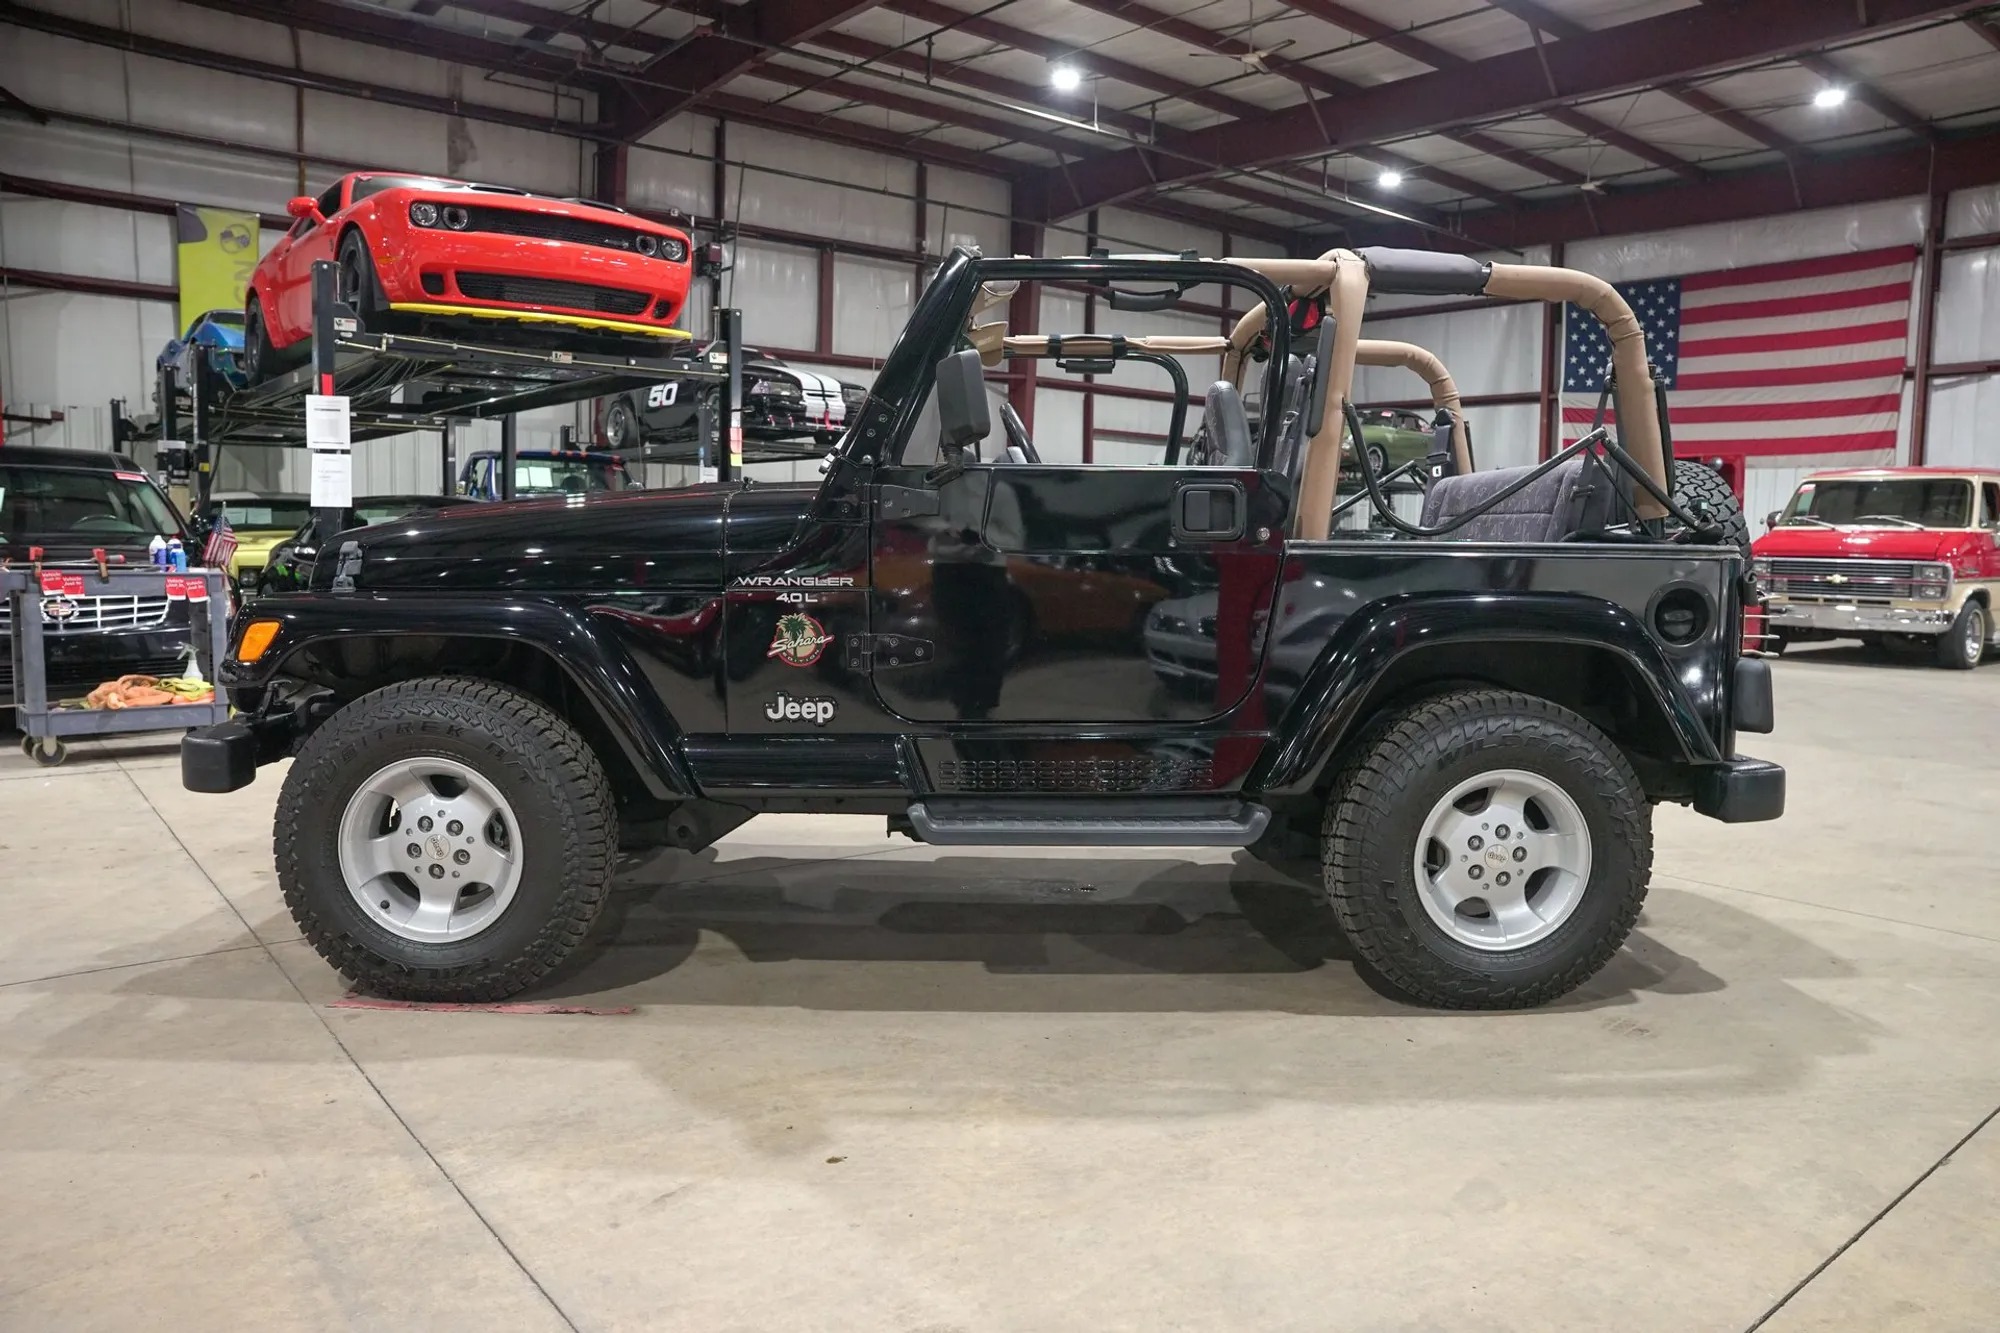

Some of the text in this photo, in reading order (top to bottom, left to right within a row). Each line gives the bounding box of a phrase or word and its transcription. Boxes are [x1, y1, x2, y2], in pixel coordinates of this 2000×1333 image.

[648, 383, 678, 408] 50
[734, 576, 854, 587] WRANGLER
[770, 634, 829, 656] Sahara
[782, 650, 820, 664] EDITION
[766, 696, 834, 723] Jeep
